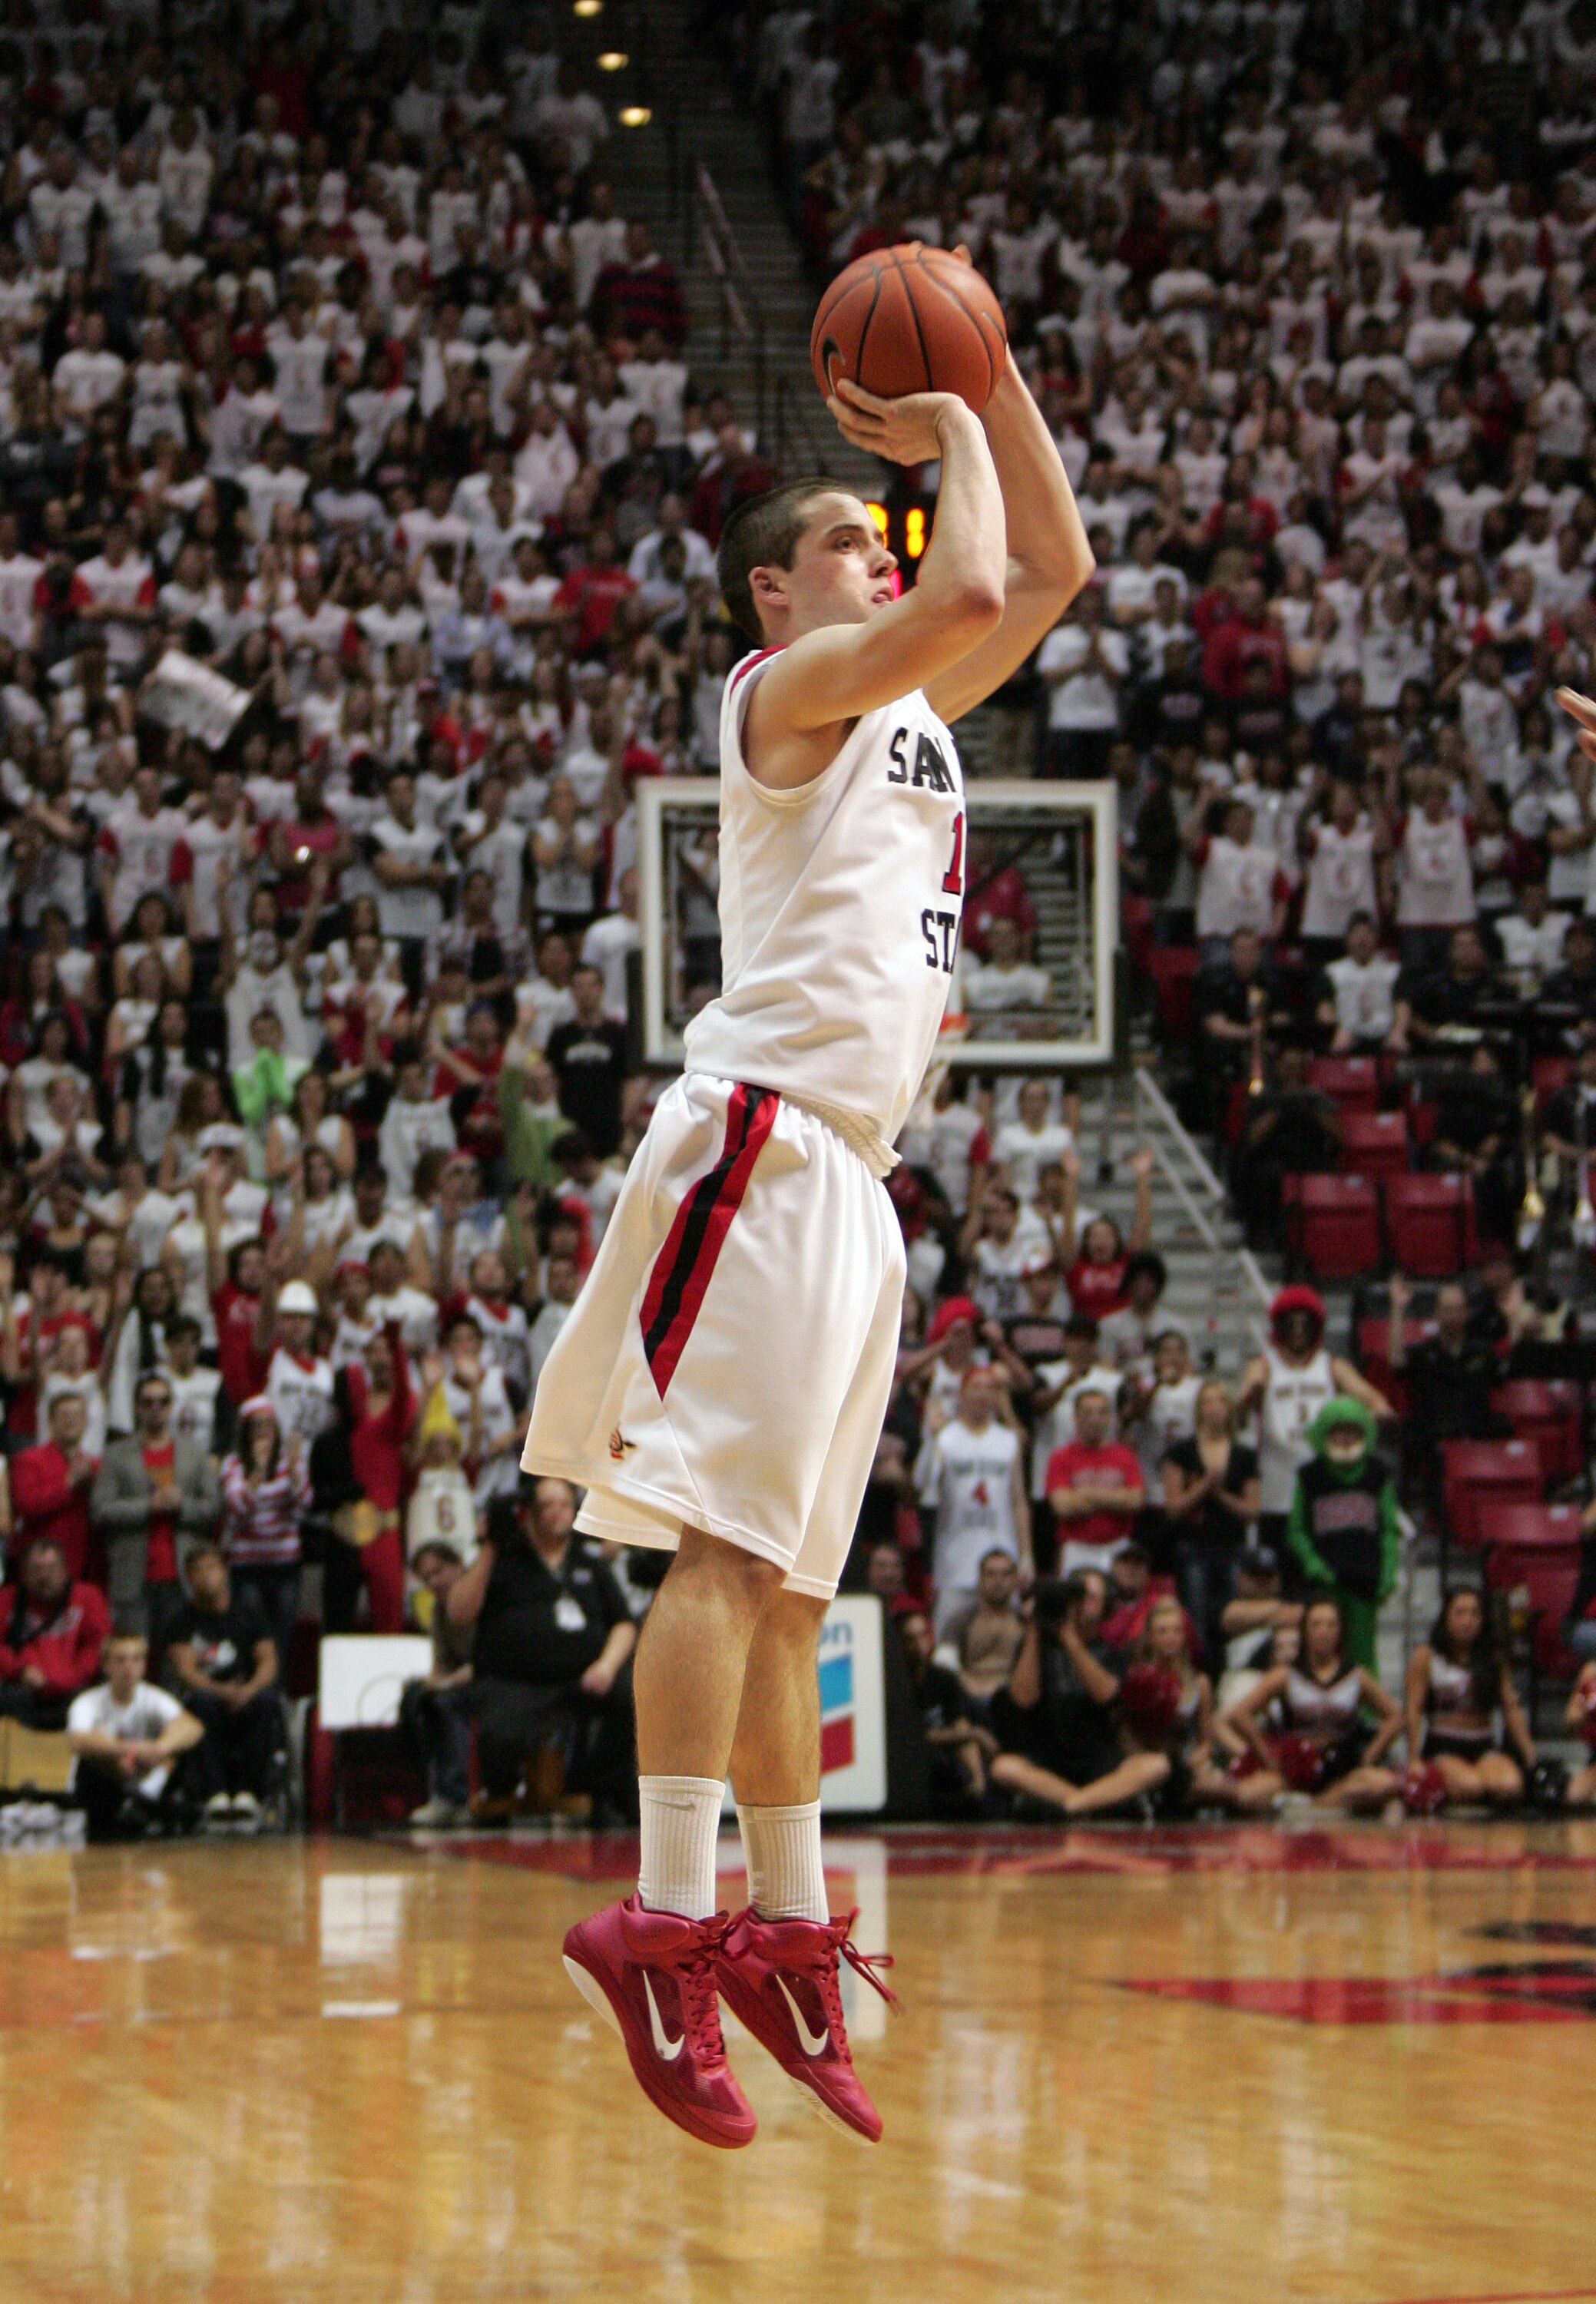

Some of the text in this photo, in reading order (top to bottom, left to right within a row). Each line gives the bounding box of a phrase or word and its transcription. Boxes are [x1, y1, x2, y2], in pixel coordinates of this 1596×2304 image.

[888, 727, 956, 793] SAN
[942, 810, 962, 895] 1
[922, 908, 958, 974] ST
[436, 1495, 455, 1534] 6
[971, 1479, 989, 1507] 4
